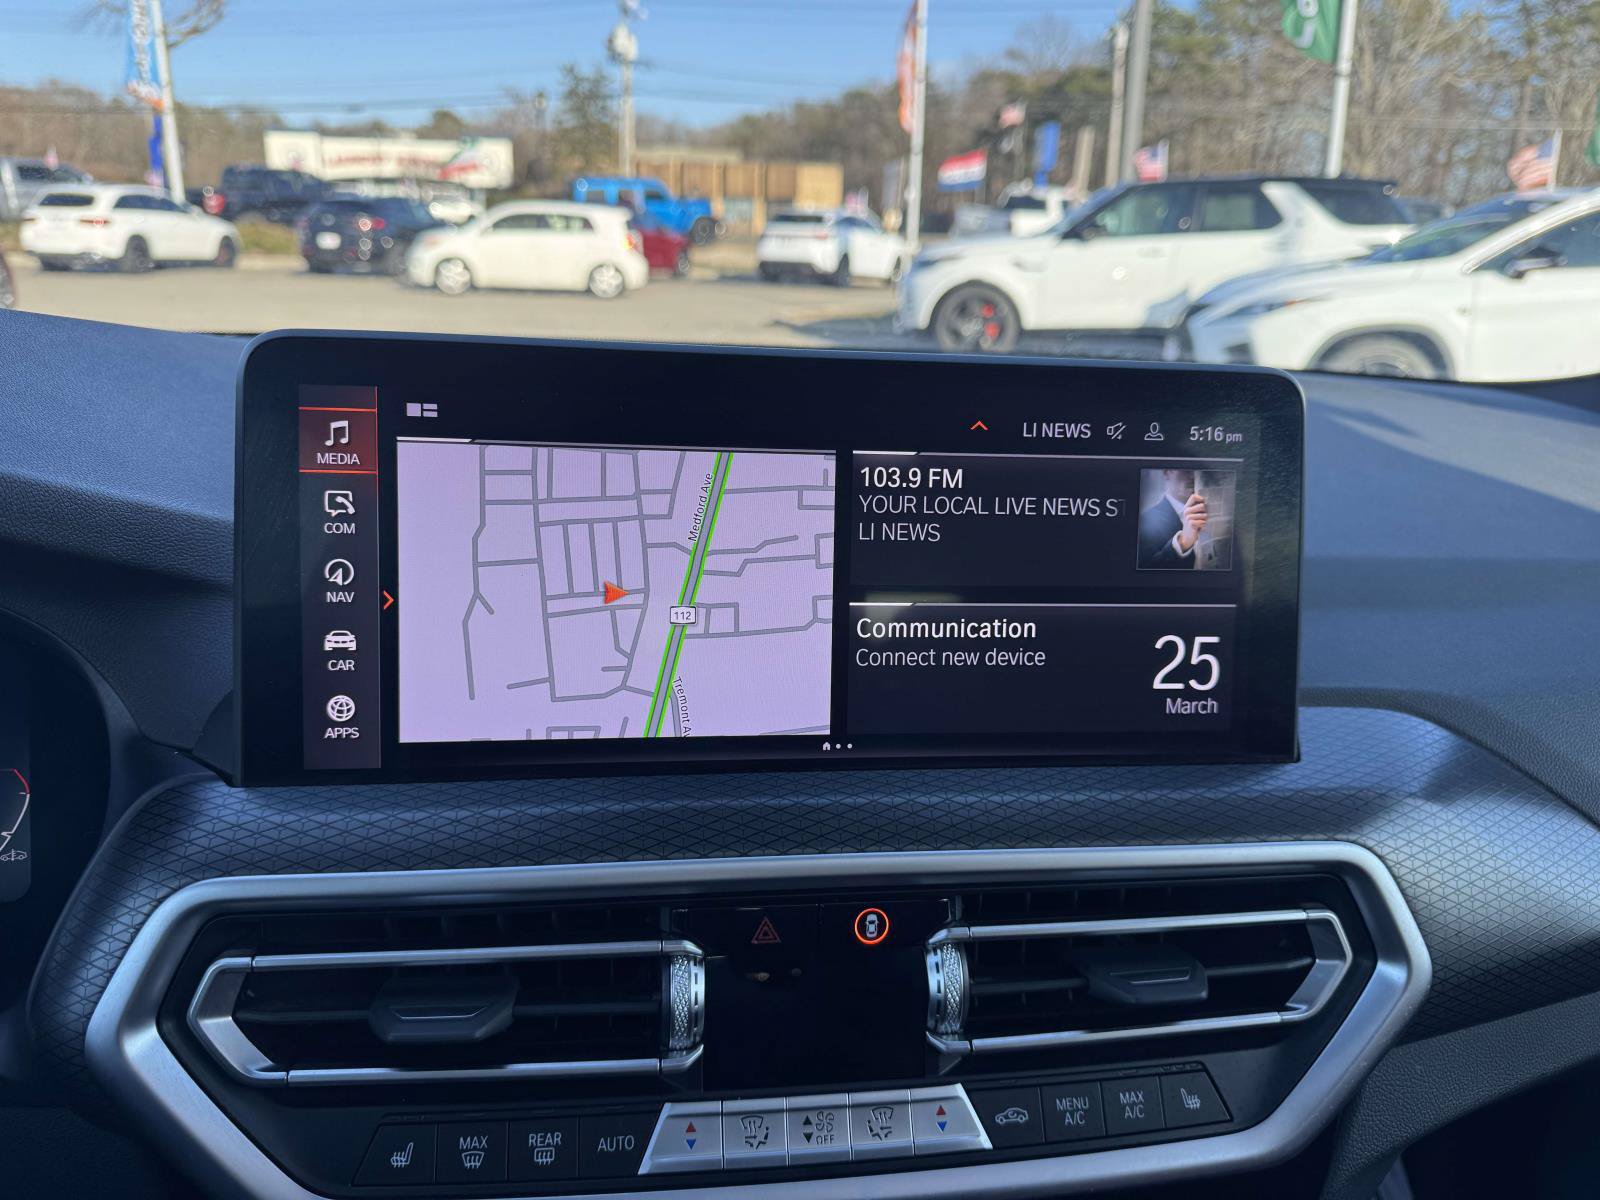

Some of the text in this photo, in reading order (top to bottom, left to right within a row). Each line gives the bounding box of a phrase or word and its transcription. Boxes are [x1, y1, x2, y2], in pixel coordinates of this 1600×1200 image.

[1022, 422, 1092, 439] LI NEWS
[1189, 425, 1243, 444] 5:16 pm
[316, 452, 361, 465] MEDIA
[860, 466, 964, 489] 103.9 FM
[687, 473, 713, 542] Medford Ave
[858, 494, 917, 515] YOUR
[923, 495, 989, 516] LOCAL
[994, 496, 1037, 516] LIVE
[1042, 497, 1101, 517] NEWS
[323, 522, 356, 535] COM
[859, 522, 941, 542] LI NEWS
[326, 591, 355, 604] NAV
[673, 611, 692, 621] 112
[856, 617, 1037, 639] Communication
[327, 659, 356, 672] CAR
[855, 648, 1046, 668] Connect new device
[1152, 634, 1221, 691] 25
[672, 676, 690, 724] Tremont
[1165, 697, 1218, 715] March
[324, 726, 360, 739] APPS
[1055, 1096, 1089, 1112] MENU
[1119, 1090, 1145, 1105] MAX
[1064, 1110, 1086, 1126] A/C
[1124, 1104, 1145, 1119] A/C
[459, 1135, 489, 1150] MAX
[528, 1131, 562, 1148] REAR
[597, 1135, 635, 1153] AUTO
[816, 1134, 835, 1145] OFF
